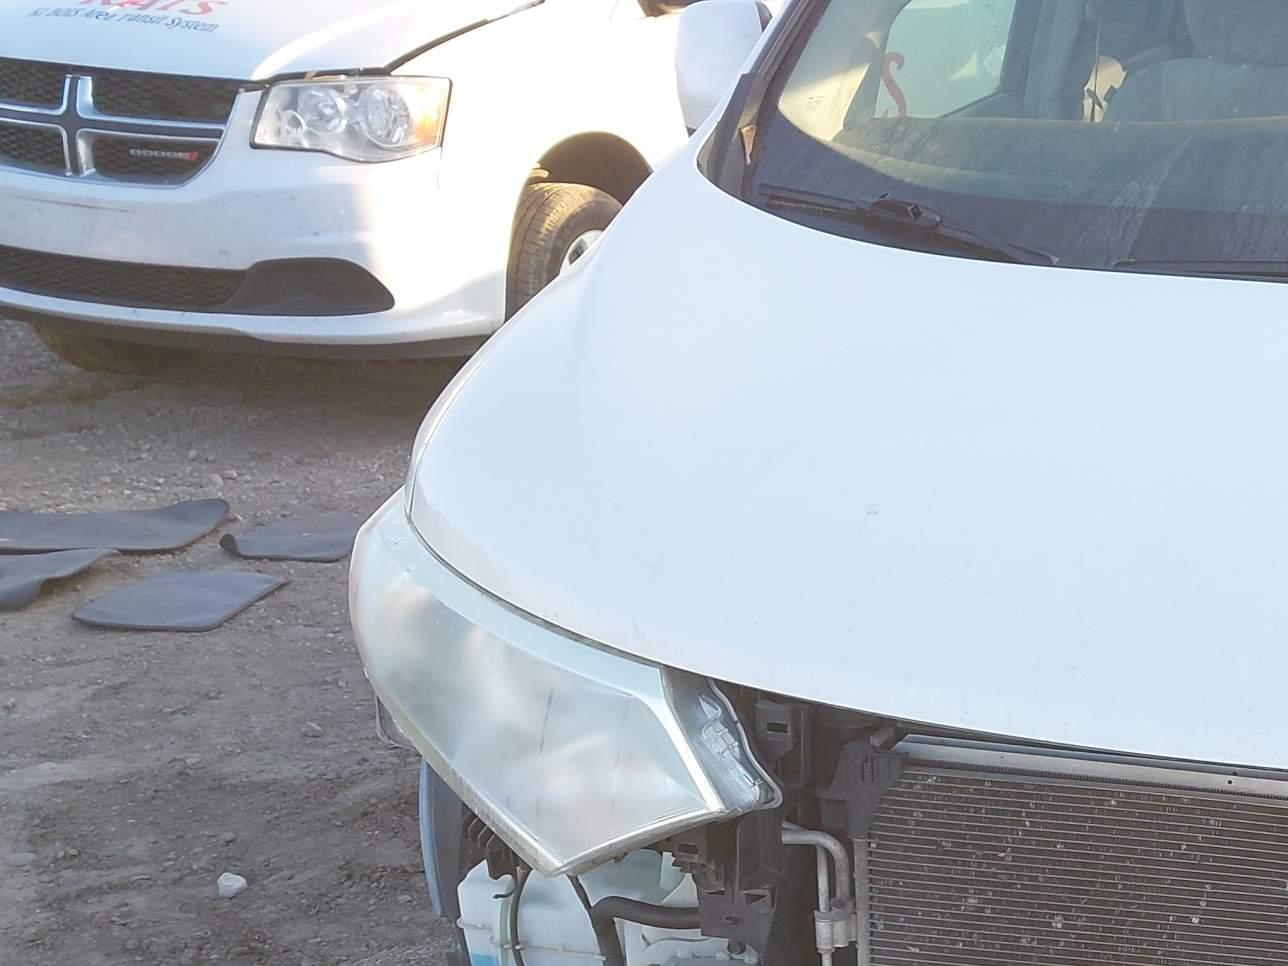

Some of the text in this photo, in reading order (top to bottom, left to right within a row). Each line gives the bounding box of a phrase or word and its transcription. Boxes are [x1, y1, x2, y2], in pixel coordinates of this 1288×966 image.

[83, 9, 116, 21] Area
[165, 17, 219, 33] System
[130, 149, 188, 160] DODGE
